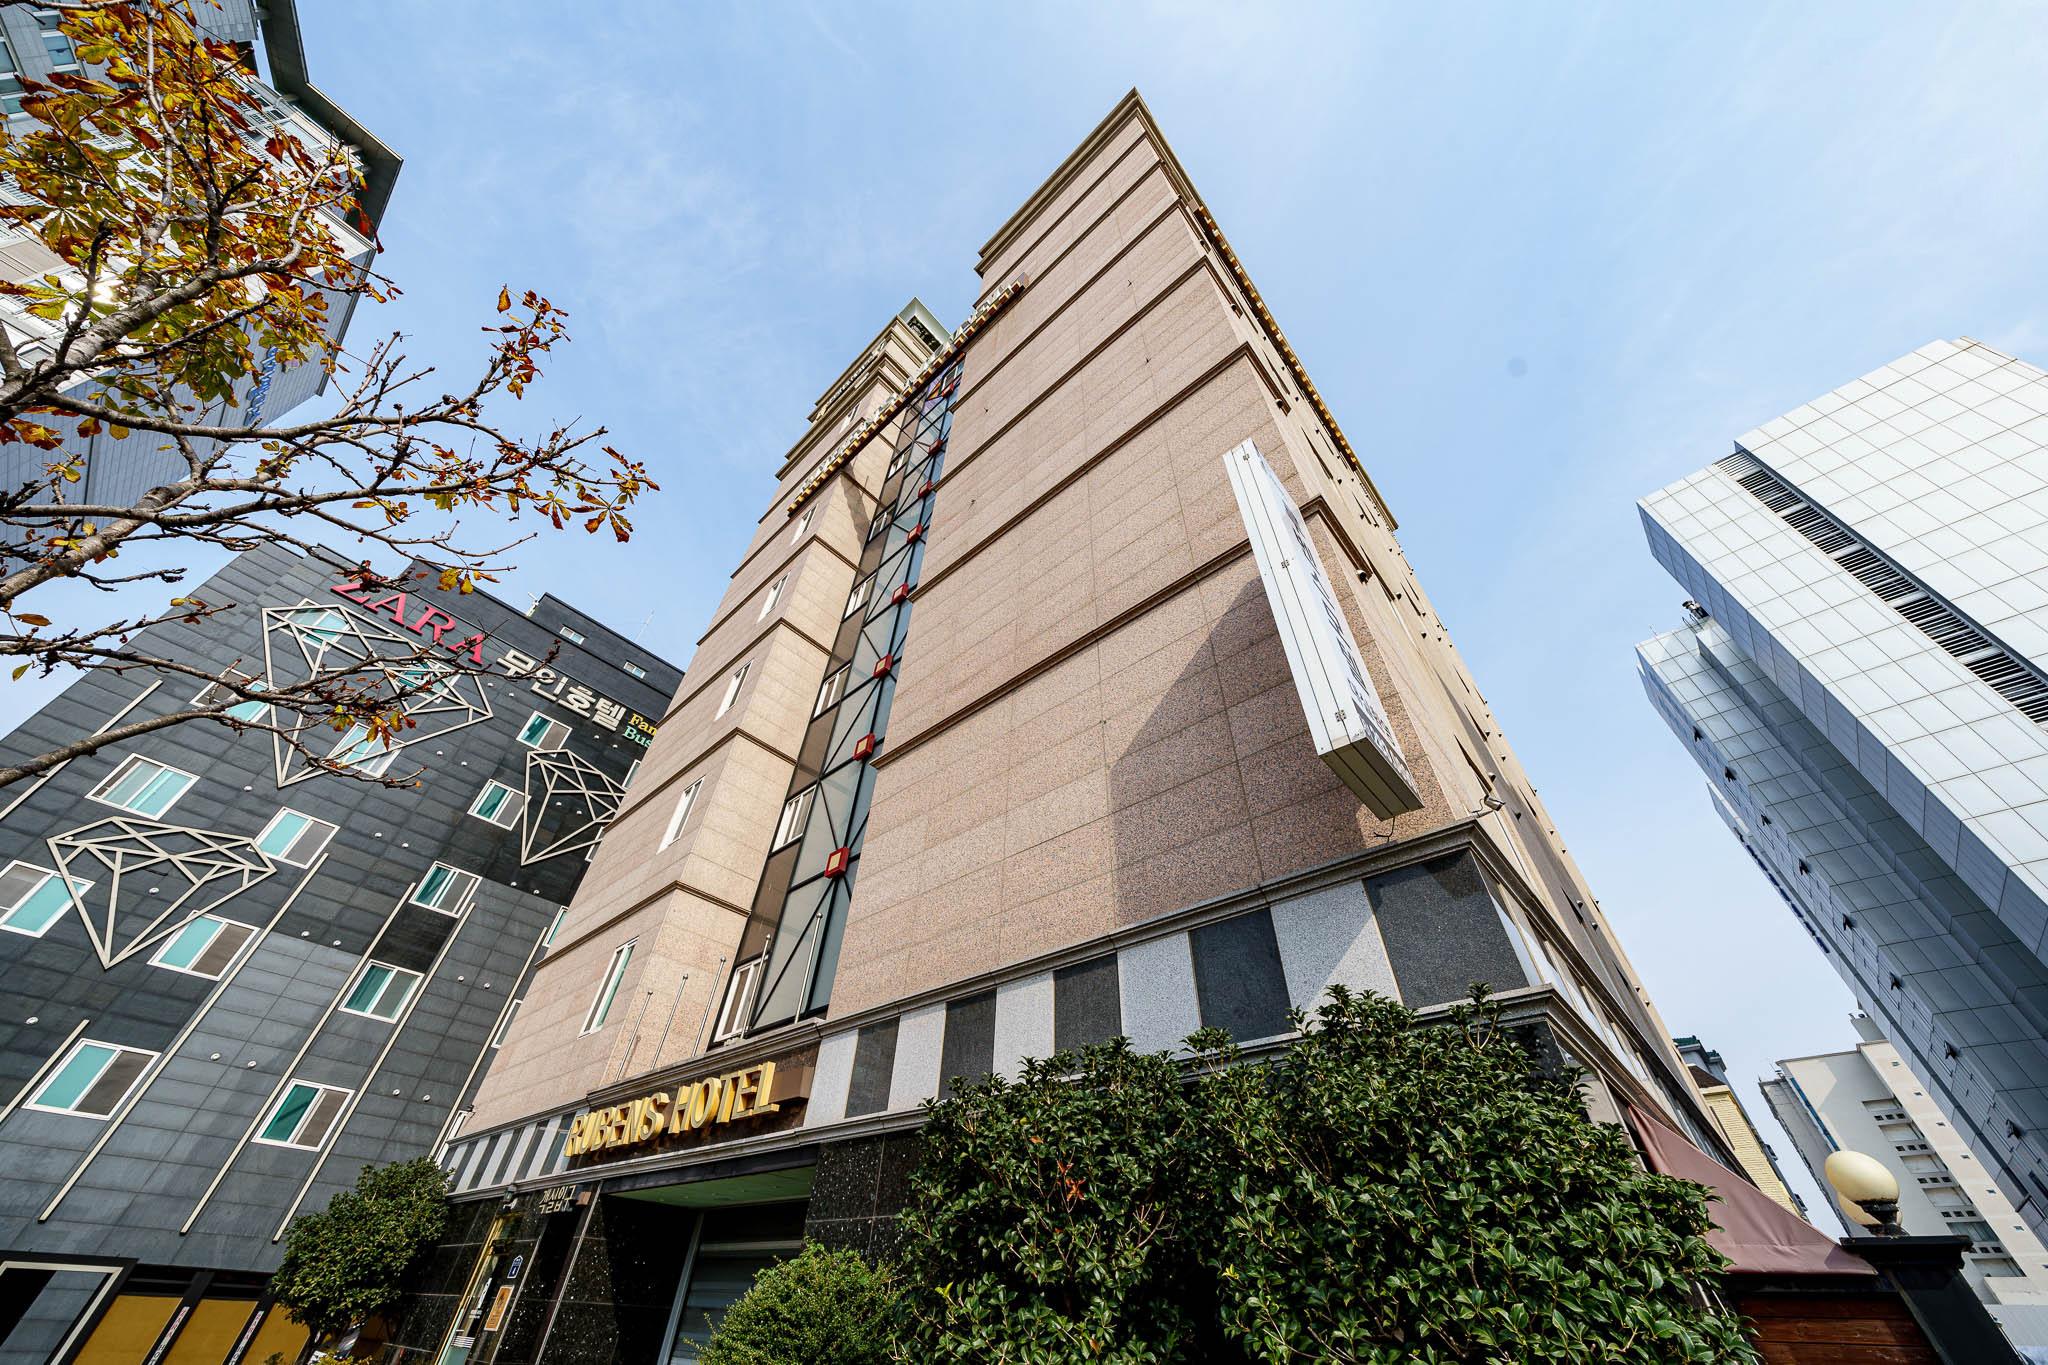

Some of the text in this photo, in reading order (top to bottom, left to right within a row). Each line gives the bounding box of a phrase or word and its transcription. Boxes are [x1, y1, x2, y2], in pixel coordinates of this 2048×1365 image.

[331, 583, 484, 665] ZARA
[496, 649, 627, 732] 무인호텔
[564, 1061, 780, 1157] RUBENS HOTEL
[539, 1185, 576, 1214] 객실입구
